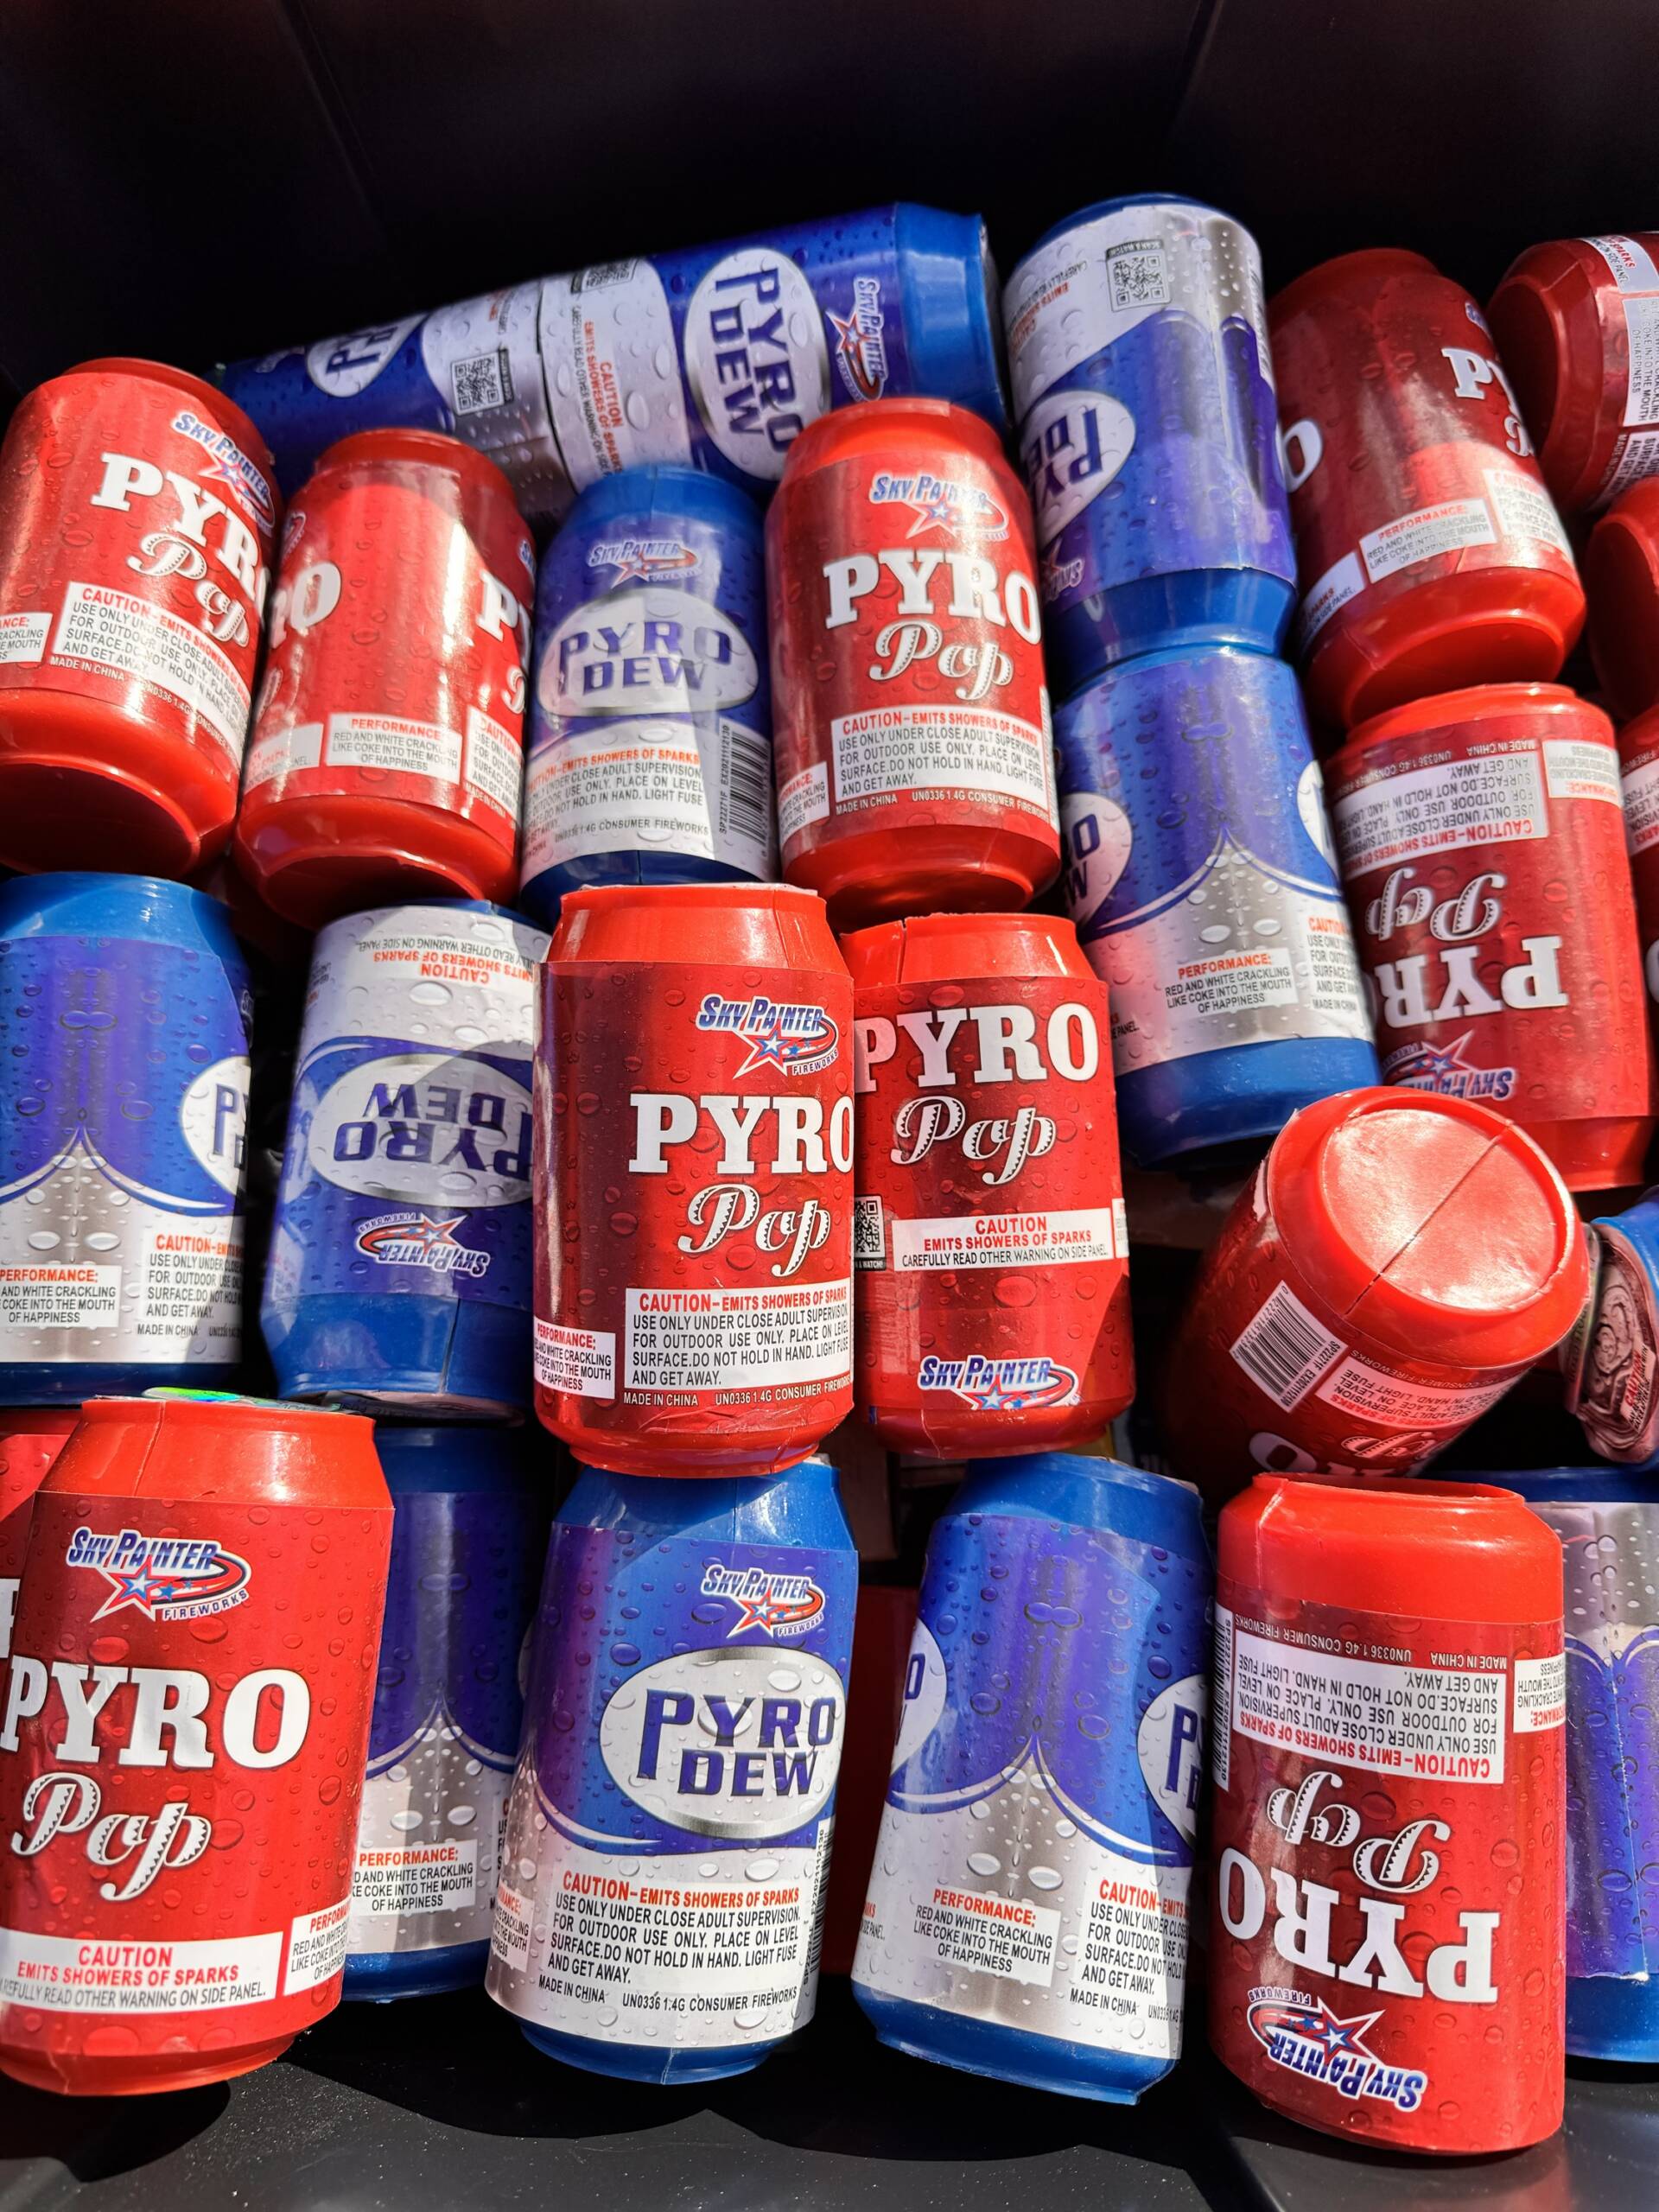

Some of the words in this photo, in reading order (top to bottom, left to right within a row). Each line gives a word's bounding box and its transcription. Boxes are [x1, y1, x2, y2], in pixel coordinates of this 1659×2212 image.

[823, 549, 1041, 645] PYRO
[870, 620, 1013, 701] Pop
[949, 715, 998, 733] SHOWERS
[373, 951, 419, 962] SPARKS
[422, 952, 439, 963] OF
[442, 953, 503, 976] SHOWERS
[421, 963, 489, 984] CAUTION
[700, 997, 747, 1027] SKY
[748, 999, 824, 1030] PAINTER
[793, 1049, 838, 1075] FIREWORKS
[855, 1003, 1098, 1093] PYRO
[363, 1083, 505, 1130] DEW
[629, 1093, 854, 1173] PYRO
[890, 1095, 1056, 1187] Pop
[677, 1183, 831, 1277] Pop
[976, 1217, 1046, 1235] CAUTION
[924, 1237, 963, 1251] EMITS
[966, 1234, 1029, 1249] SHOWERS
[1032, 1232, 1047, 1245] OF
[1051, 1230, 1091, 1245] SPARKS
[903, 1254, 950, 1267] CAREFULLY
[953, 1251, 977, 1264] READ
[979, 1251, 1011, 1264] OTHER
[1013, 1249, 1057, 1262] WARNING
[1058, 1248, 1070, 1260] ON
[1071, 1246, 1086, 1259] SIDE
[761, 1290, 810, 1309] SHOWERS
[812, 1290, 823, 1306] OF
[537, 1323, 595, 1350] PERFORMANCE:
[633, 1333, 657, 1348] FOR
[664, 1333, 722, 1349] OUTDOOR
[729, 1332, 751, 1347] USE
[790, 1328, 818, 1344] PLACE
[823, 1324, 831, 1338] ON
[921, 1357, 968, 1388] SKY
[968, 1358, 1052, 1387] PAINTER
[624, 1392, 651, 1406] MADE
[653, 1392, 664, 1406] IN
[666, 1392, 698, 1406] CHINA
[715, 1389, 751, 1405] UN0336
[753, 1389, 772, 1403] 1.4G
[775, 1384, 822, 1401] CONSUMER
[69, 1529, 117, 1567] SKY
[117, 1532, 219, 1570] PAINTER
[164, 1591, 248, 1620] FIREWORKS
[0, 1656, 310, 1768] PYRO
[1240, 1713, 1275, 1737] SPARKS
[637, 1689, 835, 1779] PYRO
[1278, 1728, 1293, 1743] OF
[1296, 1733, 1355, 1758] SHOWERS
[678, 1748, 818, 1796] DEW
[10, 1770, 213, 1901] Pop
[1268, 1770, 1451, 1893] Pop
[556, 1892, 575, 1910] USE
[578, 1895, 606, 1917] ONLY
[610, 1903, 651, 1924] UNDER
[654, 1910, 695, 1927] CLOSE
[697, 1912, 735, 1927] ADULT
[737, 1906, 800, 1926] SUPERVISION.
[683, 1891, 743, 1908] SHOWERS
[746, 1891, 760, 1905] OF
[763, 1888, 799, 1904] SPARKS
[933, 1889, 1036, 1927] PERFORMANCE:
[554, 1912, 573, 1931] FOR
[579, 1918, 636, 1942] OUTDOOR
[644, 1929, 667, 1947] USE
[674, 1932, 708, 1948] ONLY.
[714, 1932, 750, 1948] PLACE
[756, 1930, 769, 1945] ON
[773, 1926, 798, 1943] LEVEL
[916, 1904, 932, 1921] RED
[933, 1910, 953, 1926] AND
[956, 1914, 988, 1934] WHITE
[989, 1923, 1052, 1948] CRACKLING
[1220, 1847, 1499, 2003] PYRO
[79, 1946, 172, 1967] CAUTION
[548, 1952, 569, 1972] AND
[572, 1960, 593, 1977] GET
[596, 1964, 631, 1984] AWAY.
[625, 1948, 651, 1965] NOT
[654, 1950, 688, 1967] HOLD
[692, 1953, 704, 1967] IN
[708, 1952, 741, 1967] HAND.
[745, 1949, 774, 1967] LIGHT
[777, 1944, 797, 1961] FUSE
[938, 1942, 950, 1957] OF
[952, 1947, 1012, 1973] HAPPINESS
[17, 1961, 57, 1982] EMITS
[62, 1967, 143, 1986] SHOWERS
[148, 1968, 168, 1985] OF
[174, 1965, 238, 1985] SPARKS
[45, 1988, 70, 2005] READ
[74, 1991, 116, 2008] OTHER
[120, 1989, 176, 2008] WARNING
[181, 1988, 196, 2005] ON
[200, 1985, 225, 2003] SIDE
[538, 1975, 562, 1993] MADE
[563, 1982, 573, 1995] IN
[575, 1986, 605, 2003] CHINA
[622, 1993, 659, 2010] UN0336
[664, 1997, 684, 2012] 1.4G
[690, 1995, 747, 2012] CONSUMER
[752, 1986, 797, 2008] FIREWORKS
[1249, 1988, 1311, 2005] FIREWORKS
[1270, 2032, 1363, 2096] PAINTER
[1367, 2063, 1423, 2108] SKY
